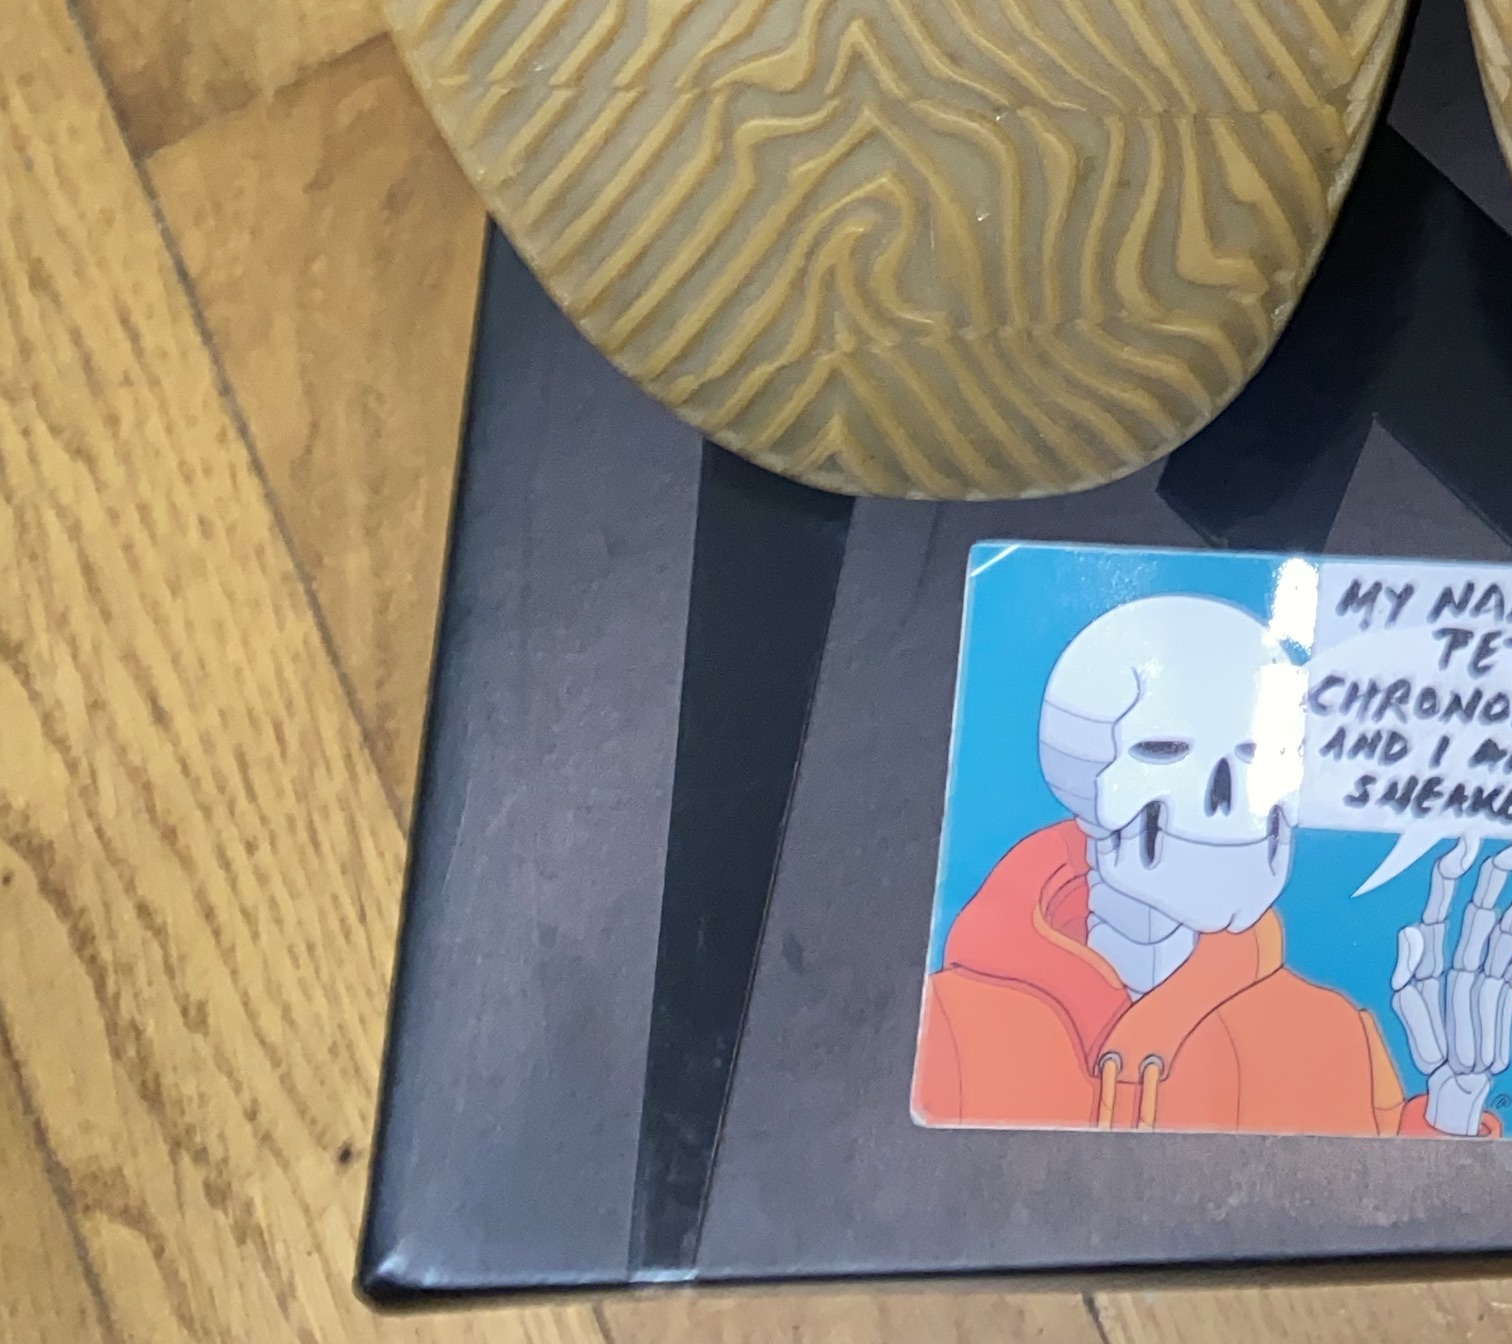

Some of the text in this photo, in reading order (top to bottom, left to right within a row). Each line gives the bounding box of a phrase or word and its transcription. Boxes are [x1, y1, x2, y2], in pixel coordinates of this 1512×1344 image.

[1335, 577, 1415, 631] MY
[1318, 725, 1409, 767] AND
[1430, 734, 1450, 768] I
